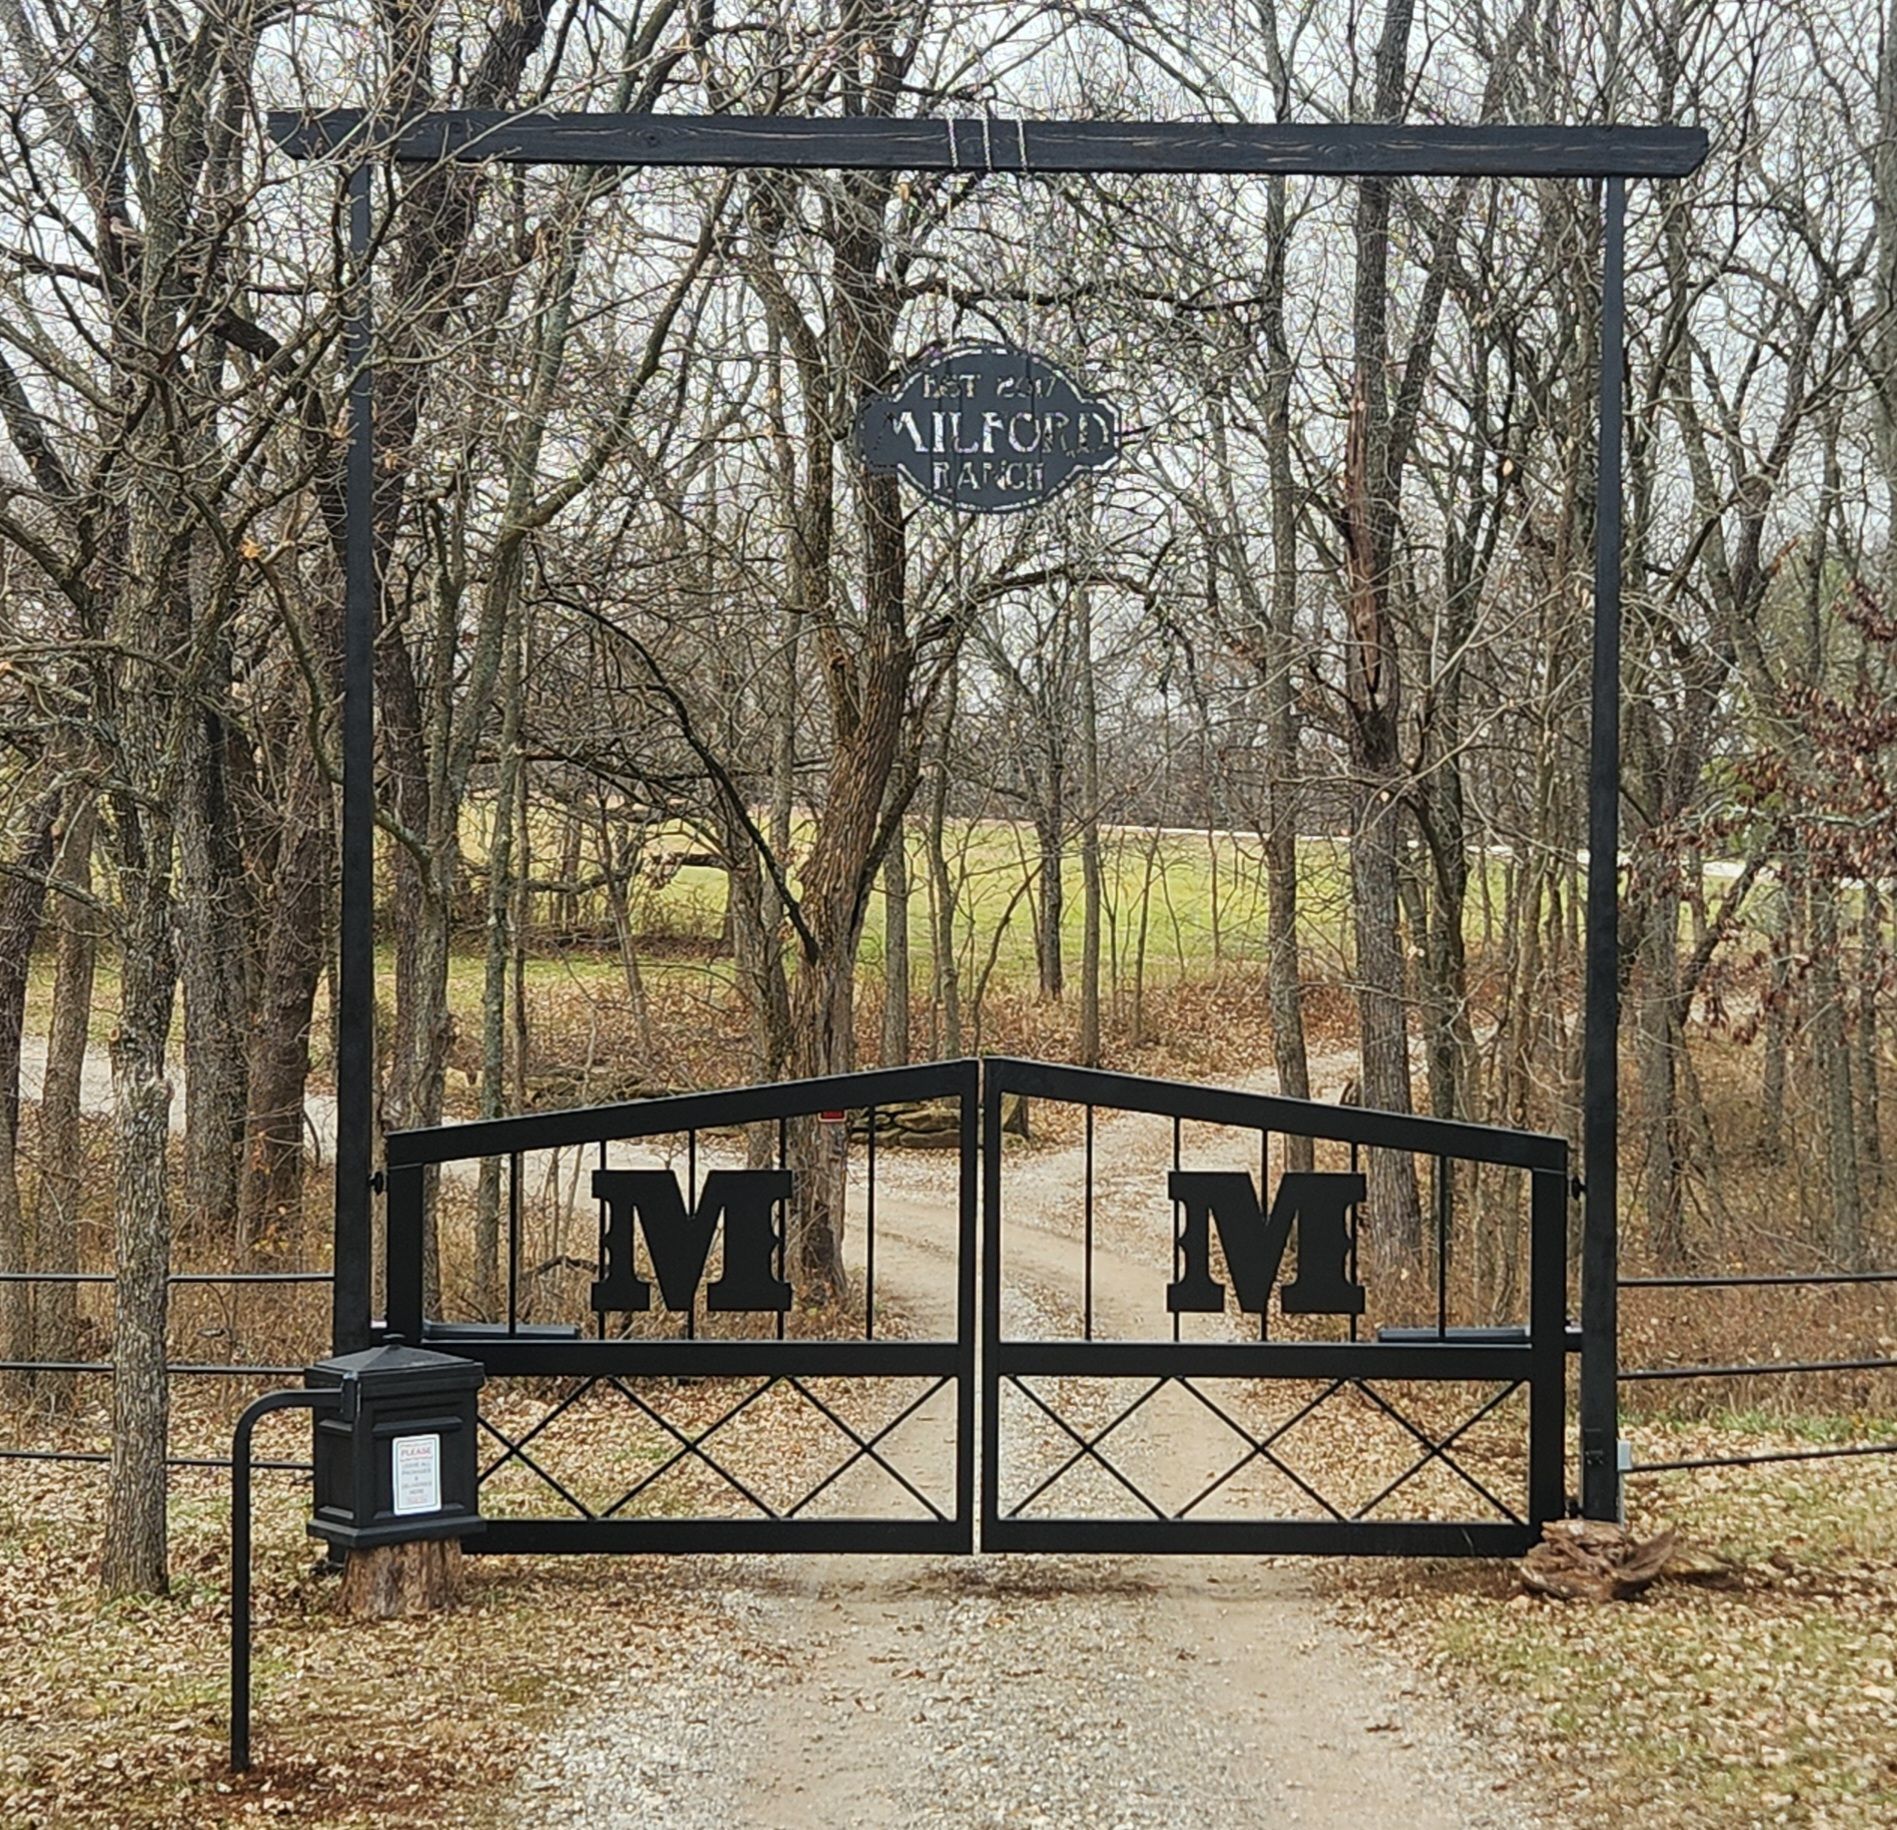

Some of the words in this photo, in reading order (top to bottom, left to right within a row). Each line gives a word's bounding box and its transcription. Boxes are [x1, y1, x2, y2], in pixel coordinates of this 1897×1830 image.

[922, 374, 982, 398] EST
[874, 412, 1110, 457] MILFORD
[932, 460, 1045, 492] RANCH
[592, 1170, 792, 1312] M
[1167, 1172, 1366, 1313] M
[400, 1446, 432, 1457] PLEASE
